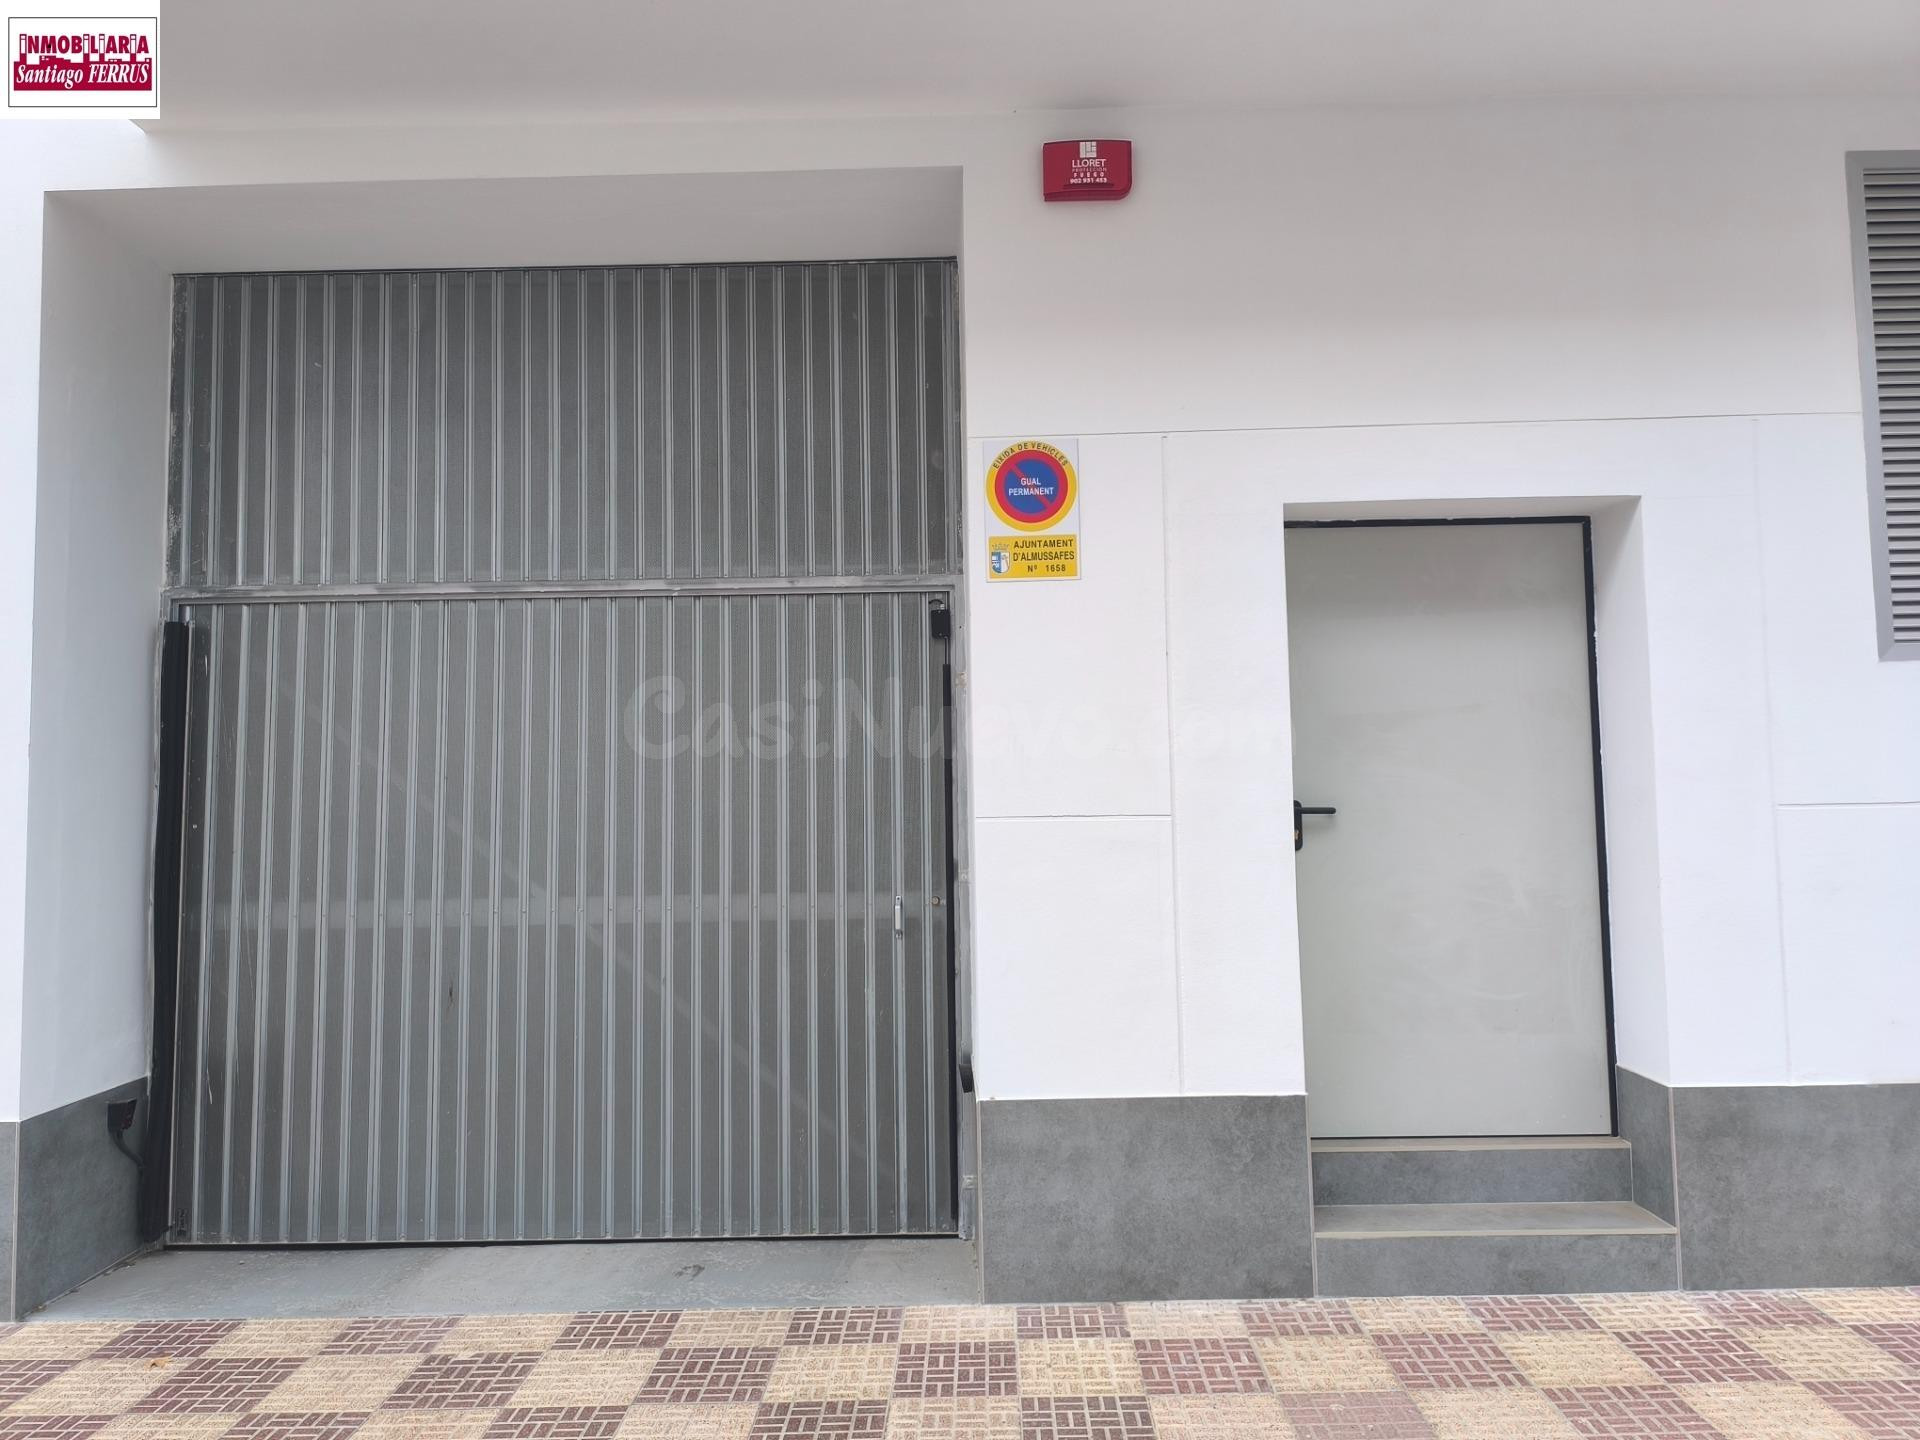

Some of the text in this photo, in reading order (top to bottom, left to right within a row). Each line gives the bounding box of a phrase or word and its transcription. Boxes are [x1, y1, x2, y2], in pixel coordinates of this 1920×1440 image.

[1072, 158, 1107, 167] LLORET
[992, 441, 1069, 470] EIXIDA DE VEHICLES
[1020, 478, 1042, 486] GUAL
[1008, 487, 1054, 496] PERMANENT
[1013, 539, 1074, 549] AJUNTAMENT
[1013, 551, 1075, 562] D'ALMUSSAFES
